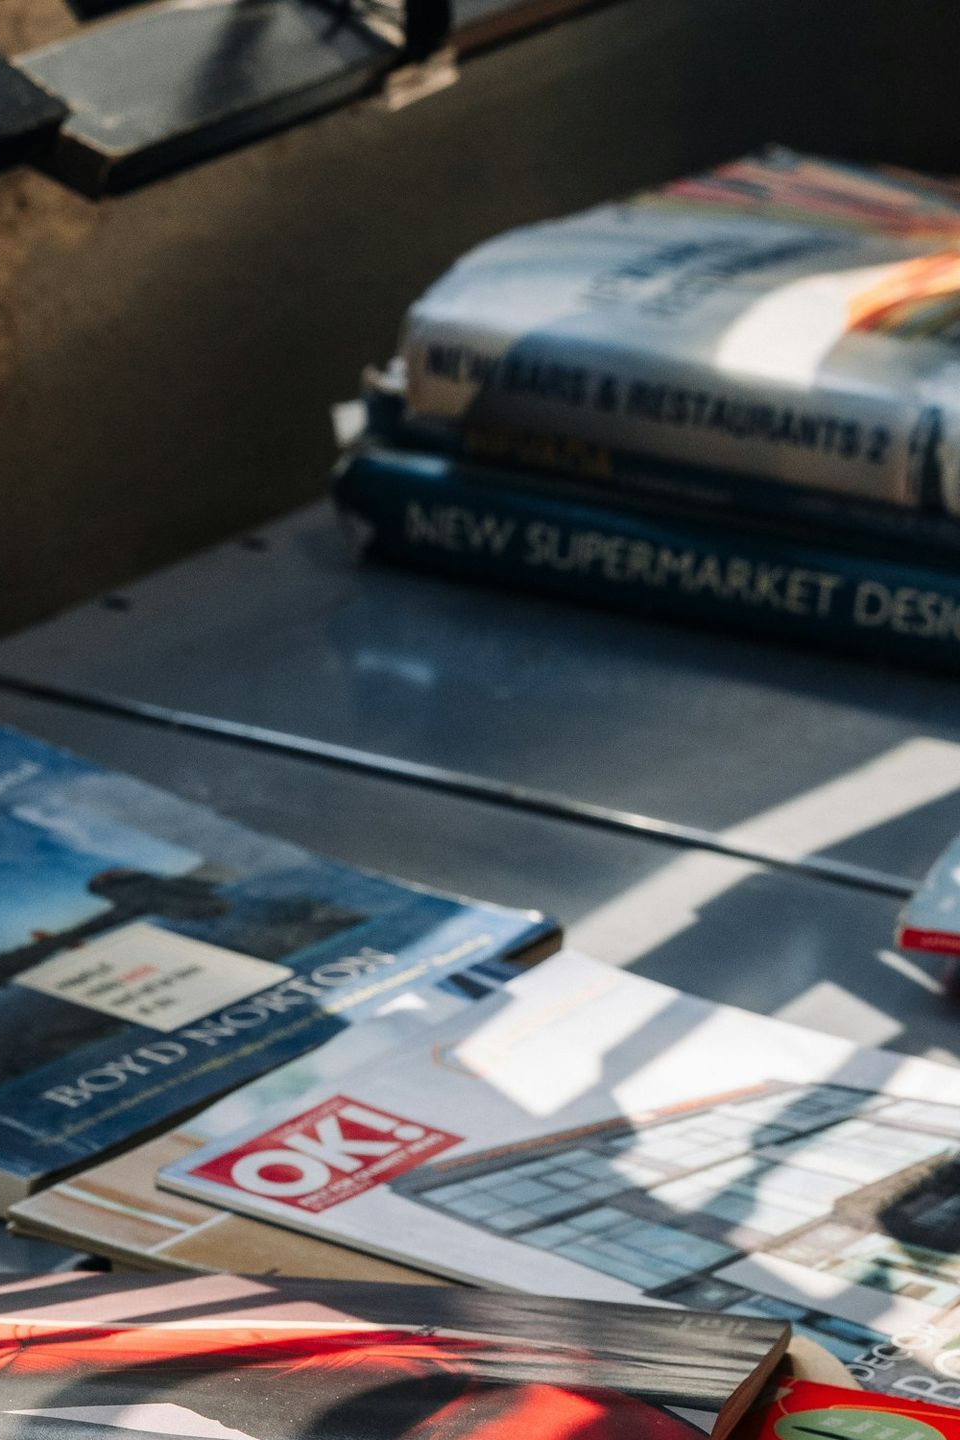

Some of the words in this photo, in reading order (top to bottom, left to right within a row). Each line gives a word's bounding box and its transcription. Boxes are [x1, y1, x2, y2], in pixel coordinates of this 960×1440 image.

[404, 502, 517, 555] NEW
[524, 516, 844, 619] SUPERMARKET
[41, 1040, 189, 1110] BOYD
[182, 945, 397, 1048] NORTON
[230, 1104, 426, 1198] OK!
